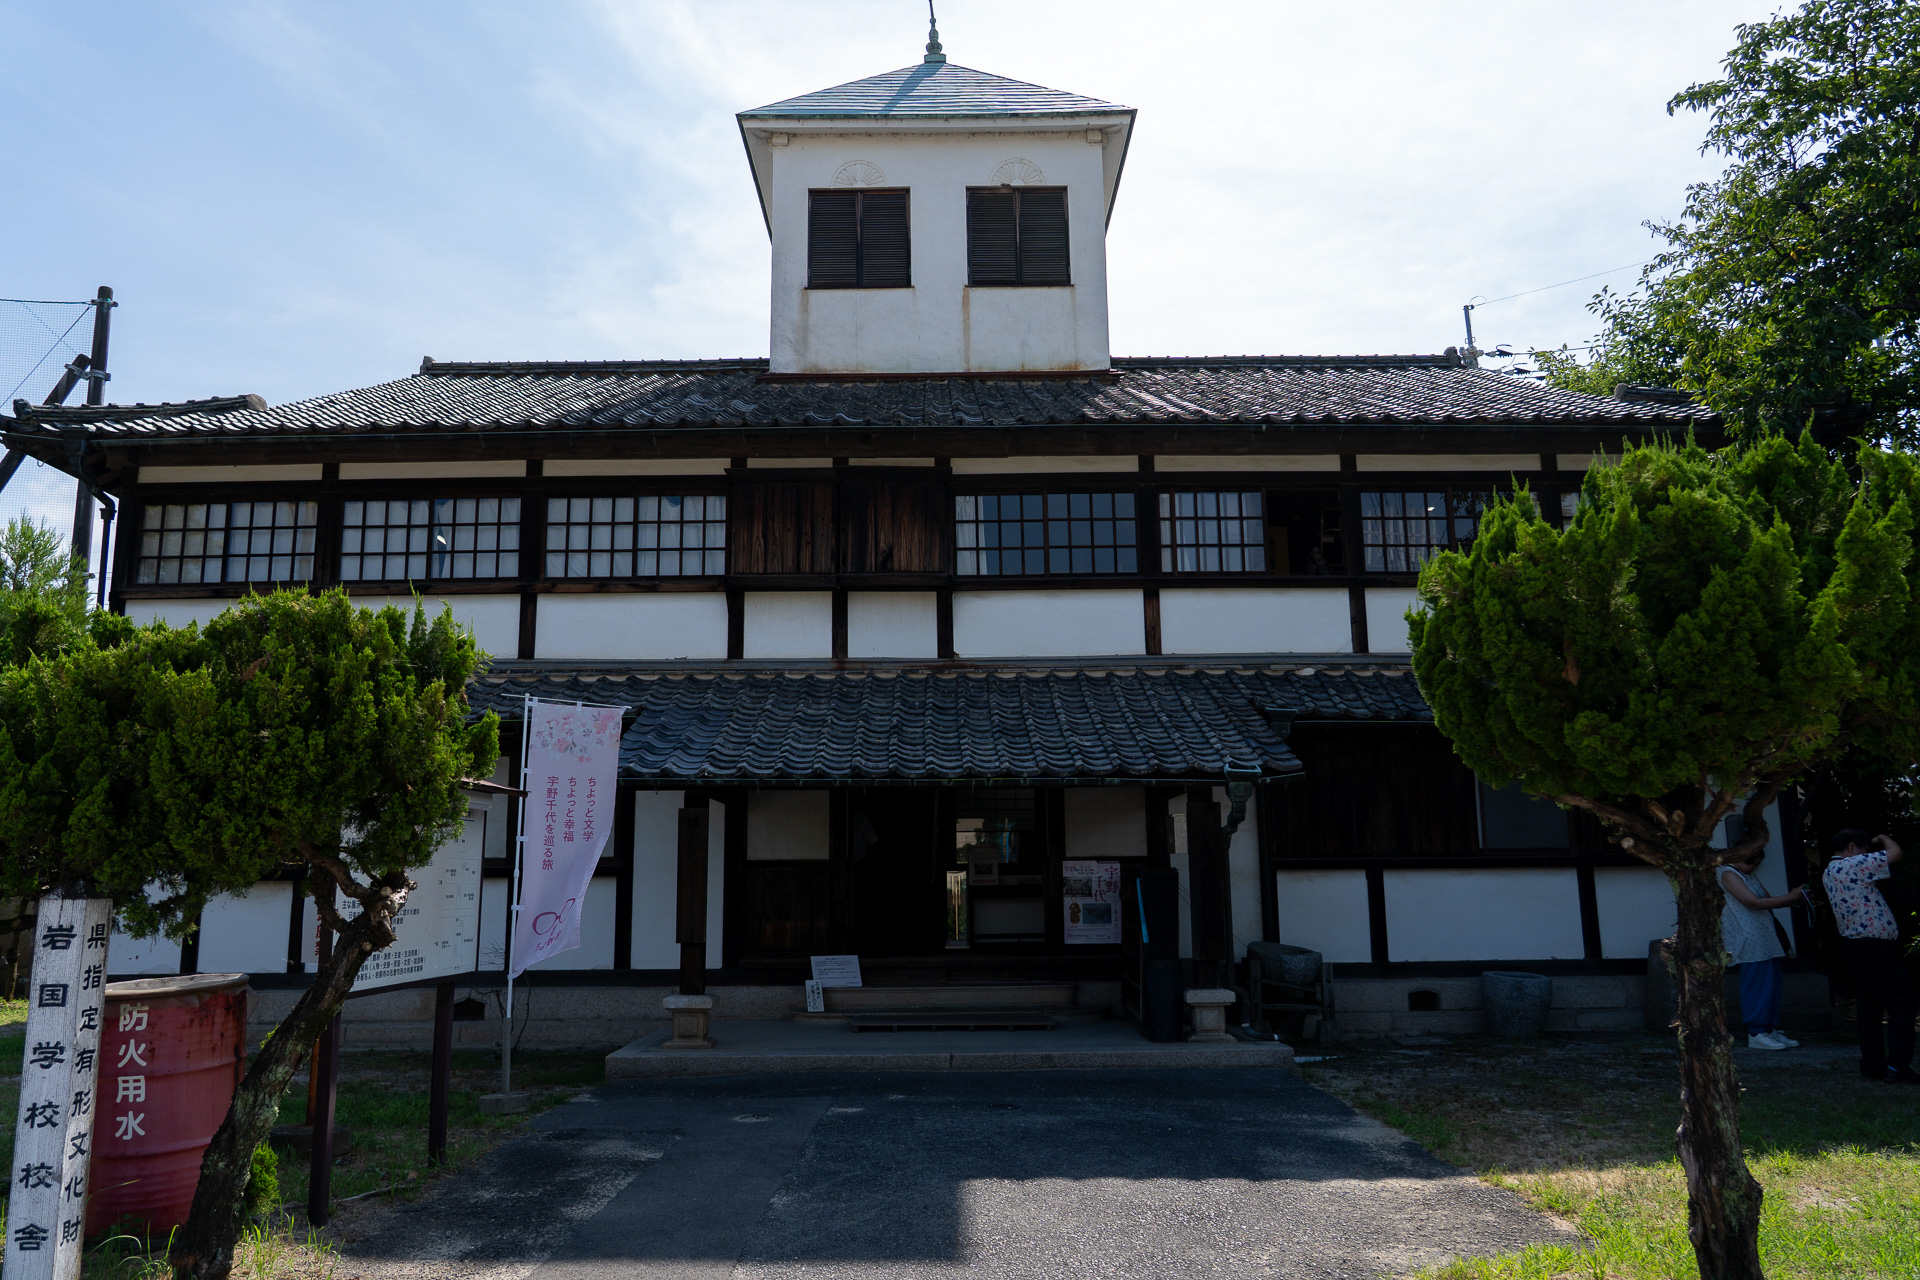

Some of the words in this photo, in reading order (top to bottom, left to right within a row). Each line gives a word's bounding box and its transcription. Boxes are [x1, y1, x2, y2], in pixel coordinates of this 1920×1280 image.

[542, 775, 559, 871] 宇野千代を巡る旅
[14, 924, 78, 1252] 岩国学校校舎
[60, 923, 107, 1247] 県指定有形文化財
[115, 1003, 149, 1141] 防火用水
